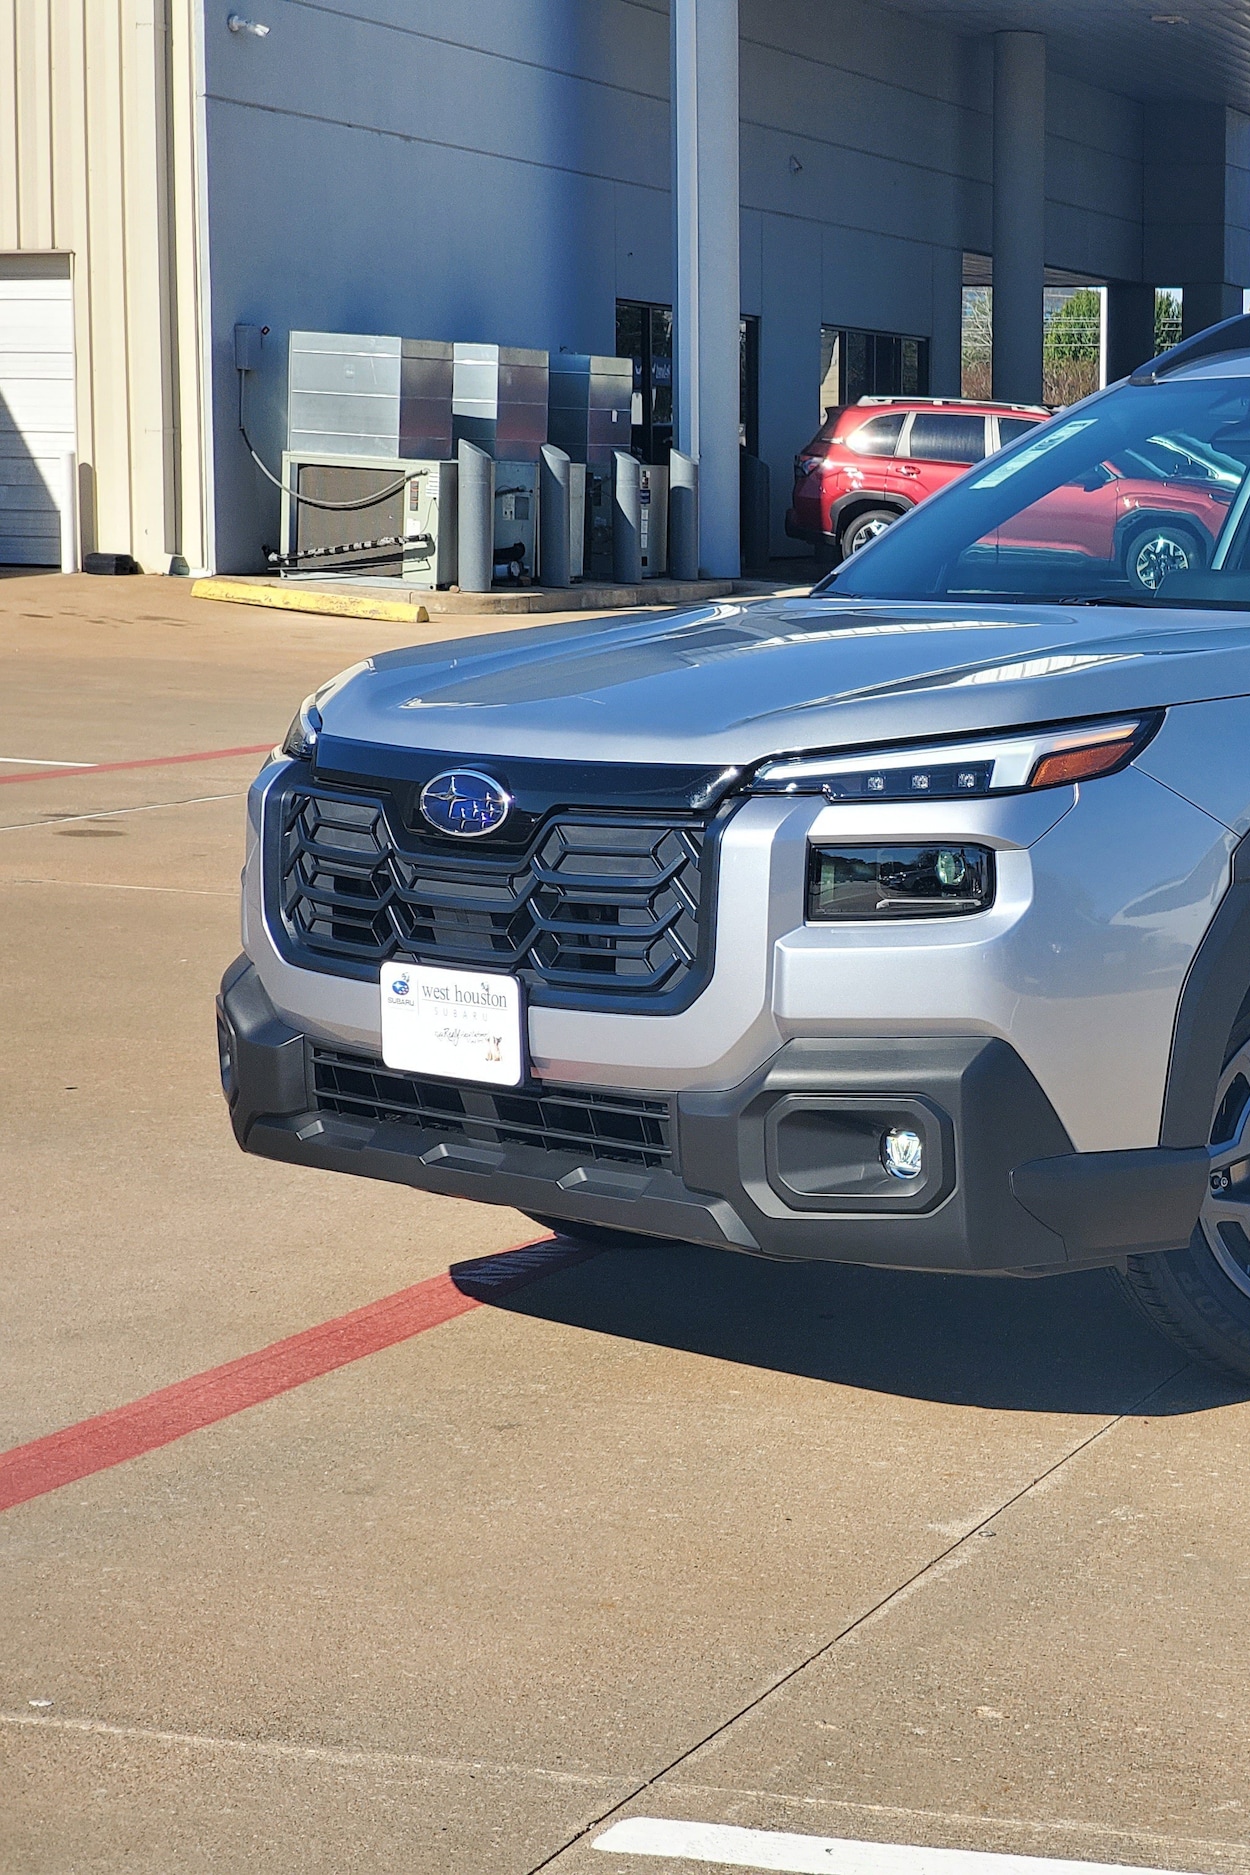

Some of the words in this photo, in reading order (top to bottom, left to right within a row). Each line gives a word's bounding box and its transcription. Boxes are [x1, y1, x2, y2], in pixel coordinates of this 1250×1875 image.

[387, 997, 415, 1008] SUBARU
[421, 985, 451, 1002] west
[455, 984, 508, 1008] houston
[434, 1007, 489, 1022] SUBARU
